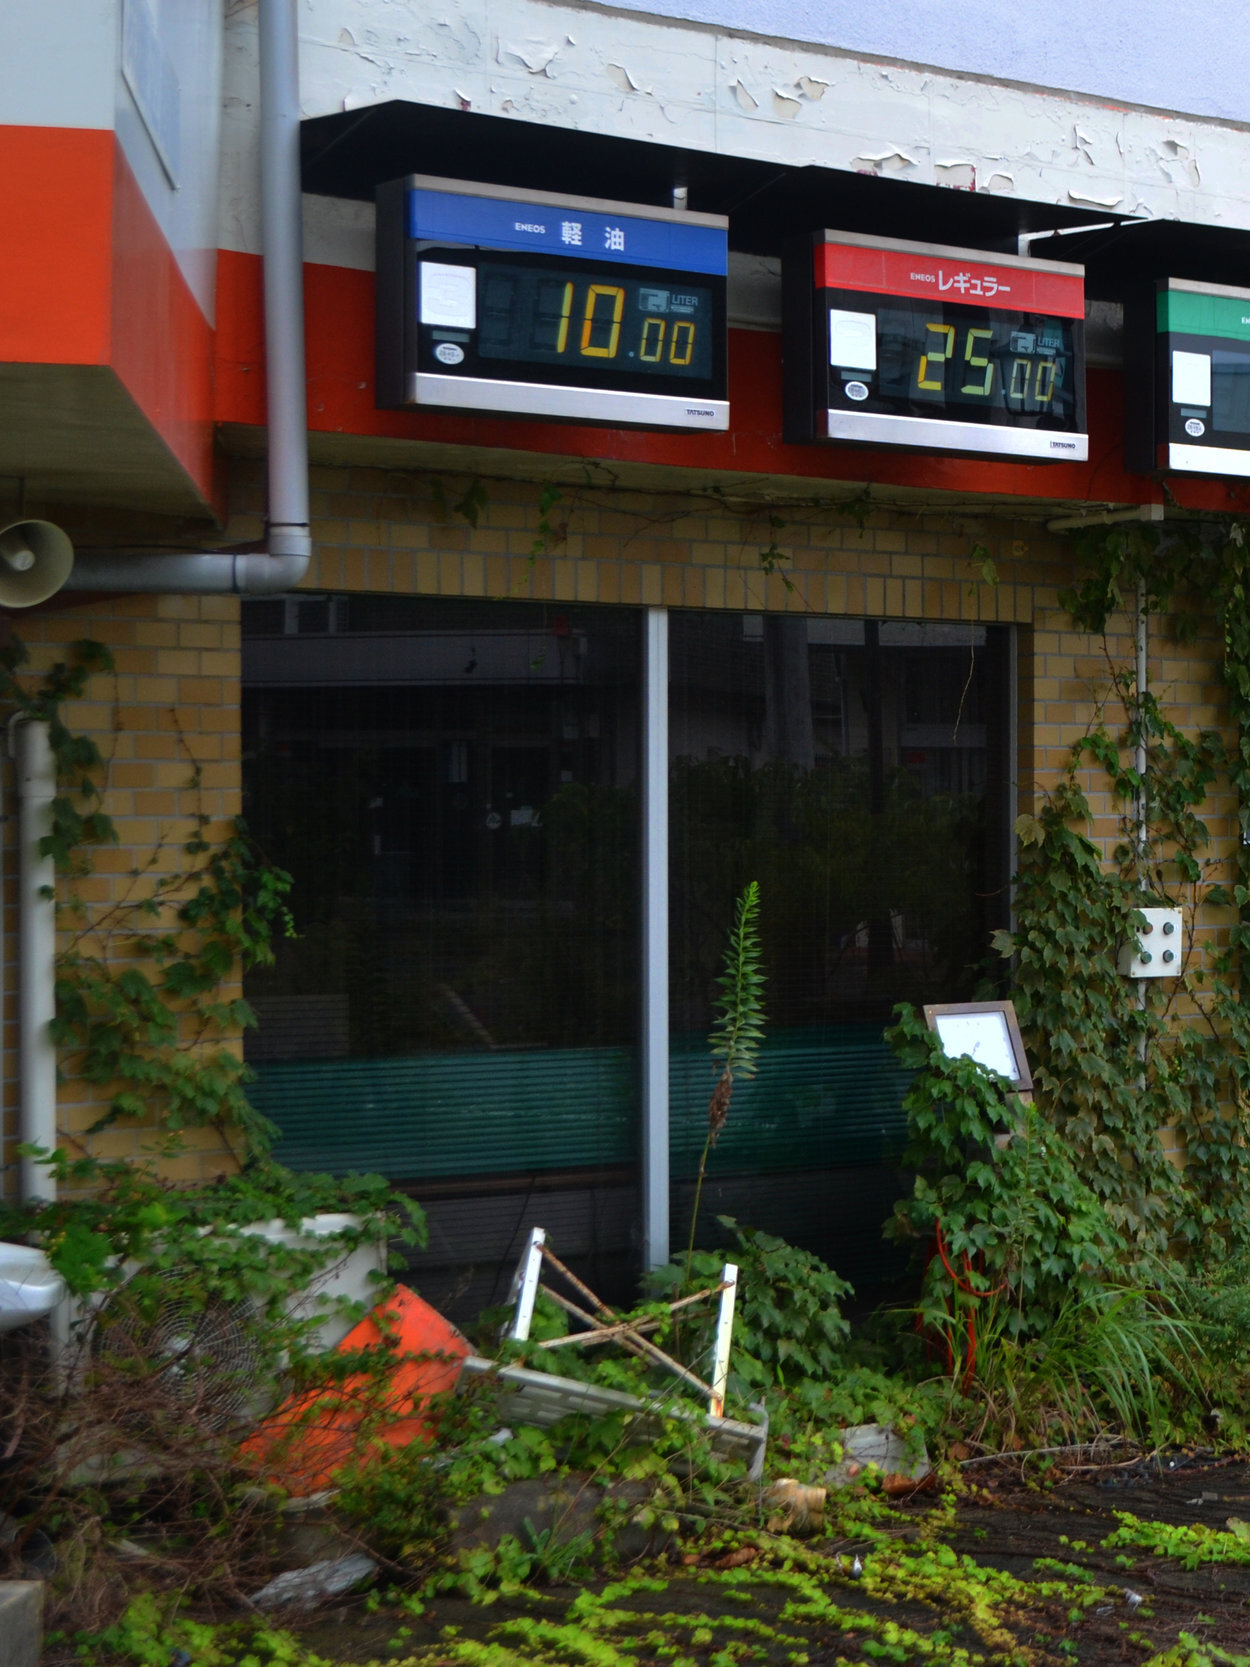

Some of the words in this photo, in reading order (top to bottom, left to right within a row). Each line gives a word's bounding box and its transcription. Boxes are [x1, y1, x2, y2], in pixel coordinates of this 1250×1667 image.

[514, 222, 546, 234] ENEOS
[910, 272, 935, 283] ENEOS
[938, 270, 1011, 297] レギュラー
[686, 409, 715, 417] TATSUNO
